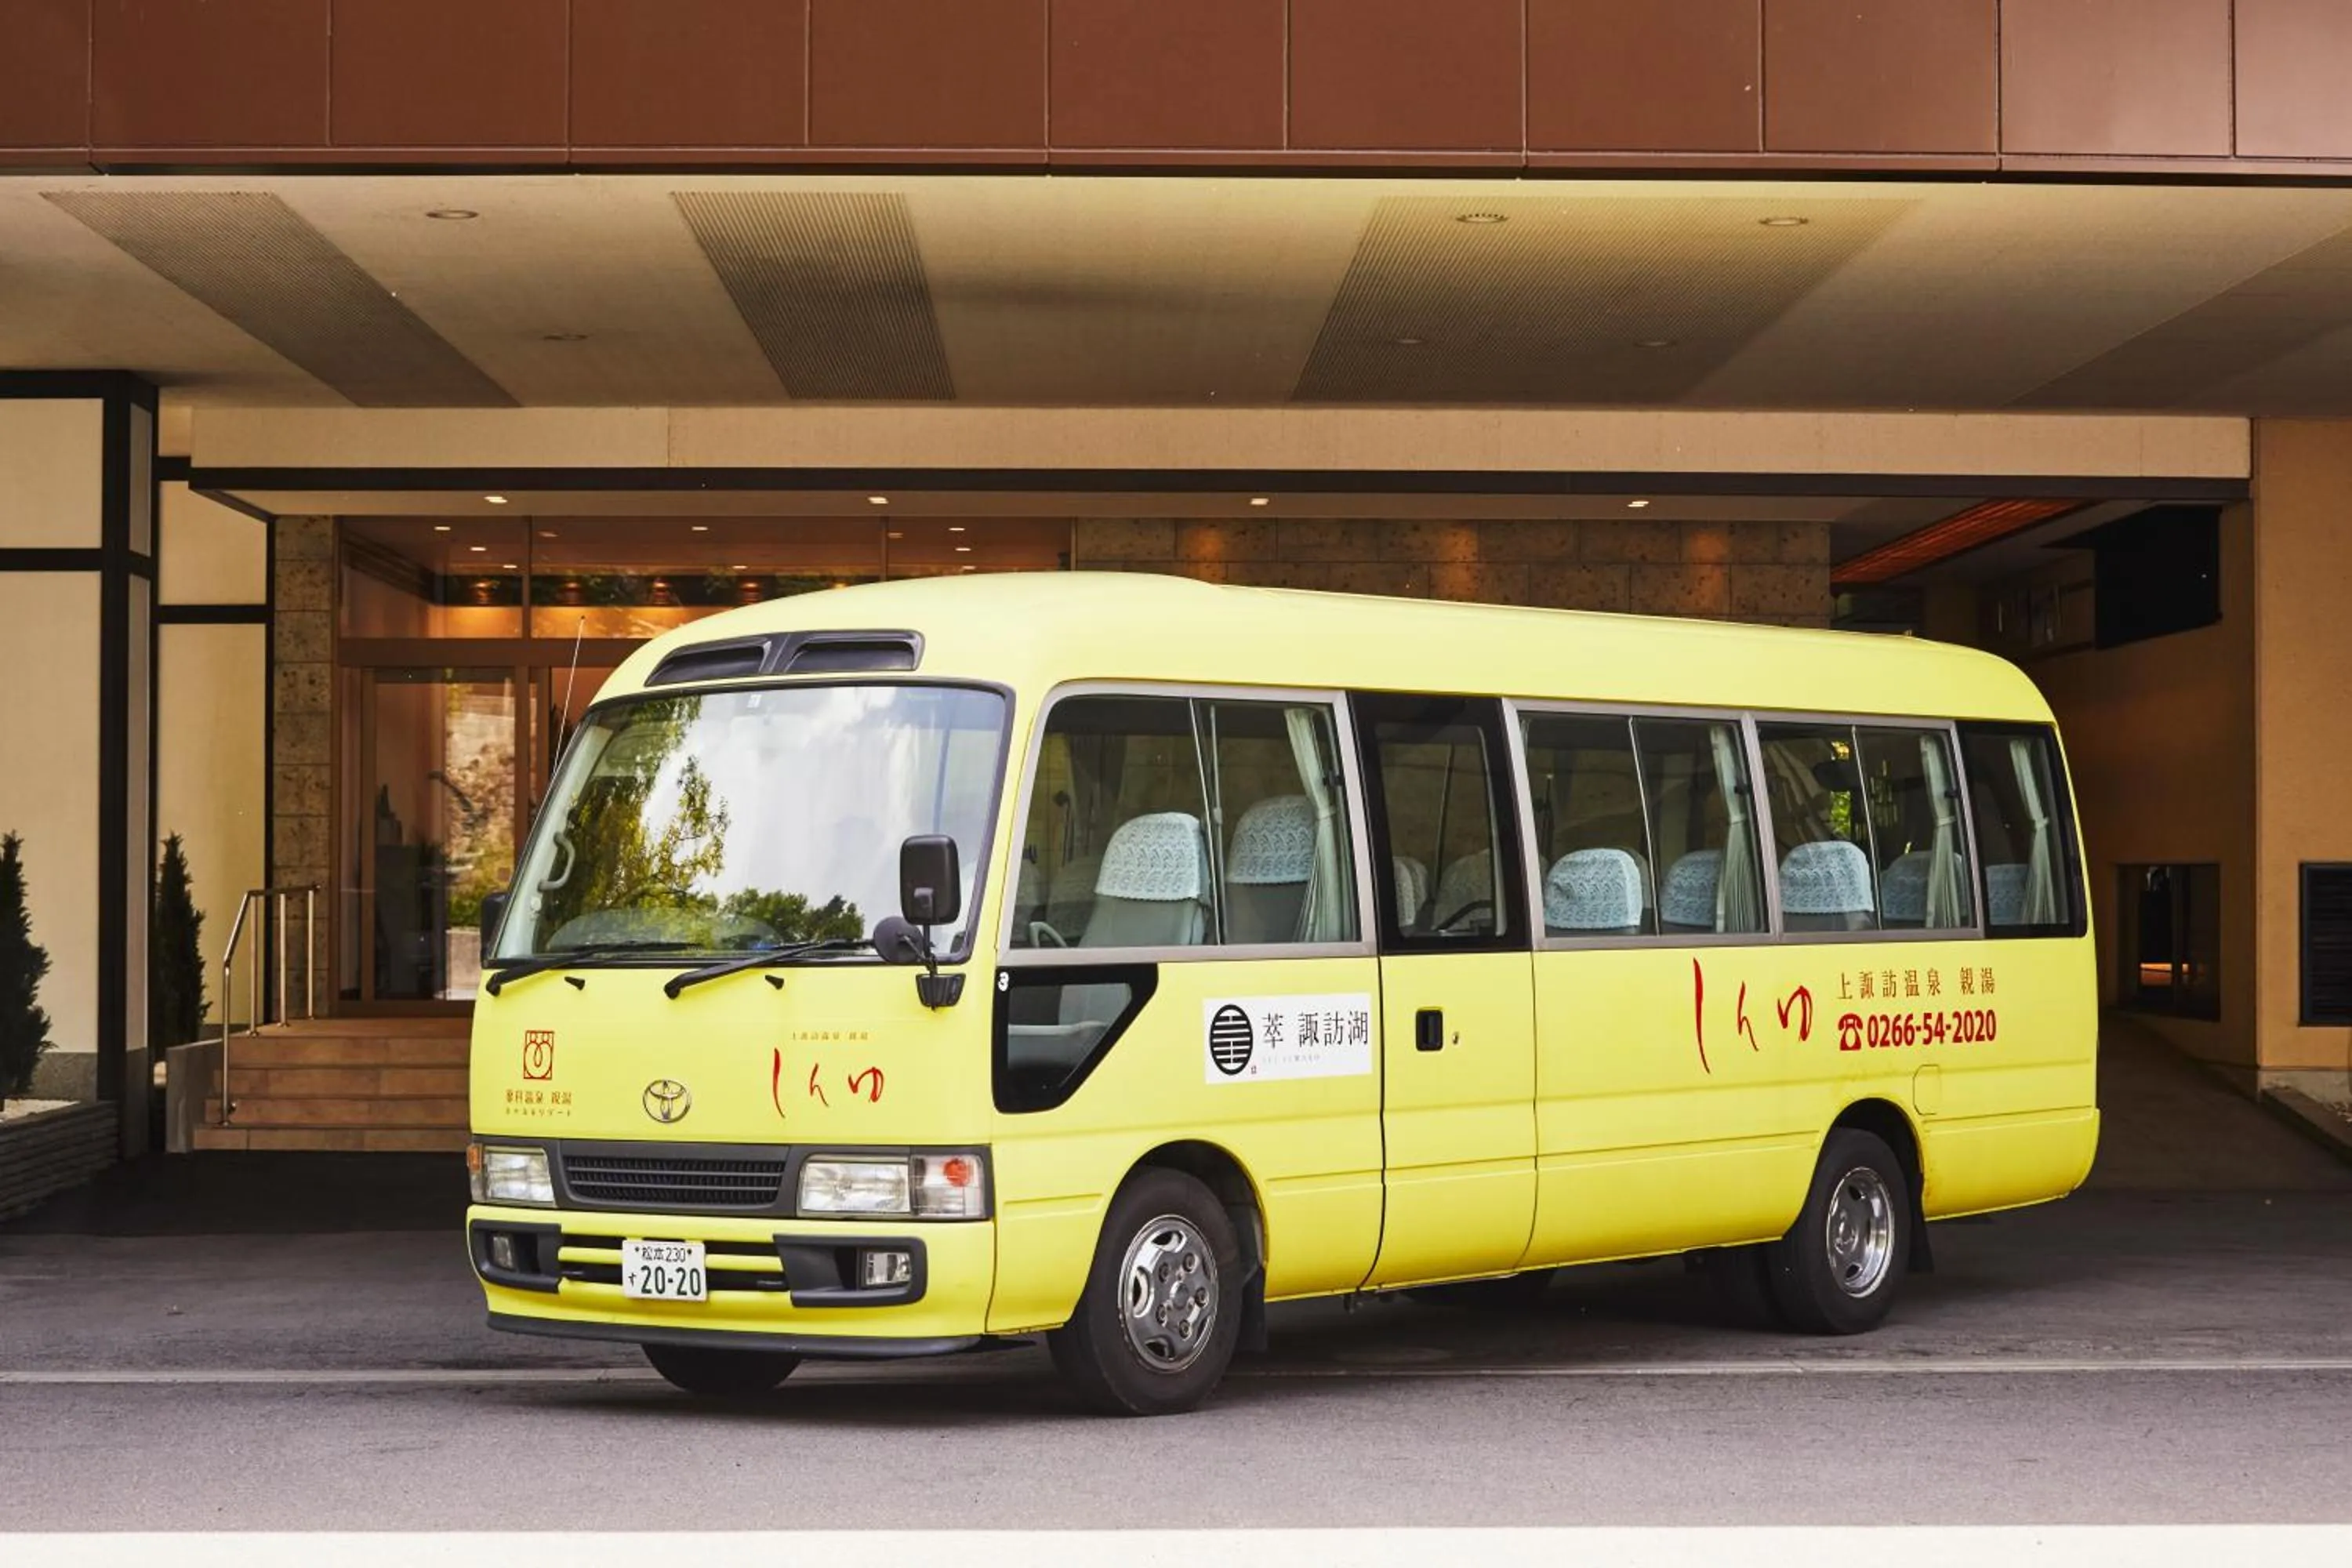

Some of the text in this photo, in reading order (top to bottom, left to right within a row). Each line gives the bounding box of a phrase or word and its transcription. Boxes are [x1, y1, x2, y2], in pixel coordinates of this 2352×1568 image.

[998, 971, 1009, 992] 3
[1837, 967, 1996, 1000] 上諏訪温泉 親湯
[1298, 1010, 1369, 1047] 諏訪湖
[1693, 957, 1813, 1075] しんゆ
[1867, 1009, 1997, 1048] 0266-54-2020
[772, 1047, 884, 1119] しんゆ
[641, 1265, 701, 1296] 20-20
